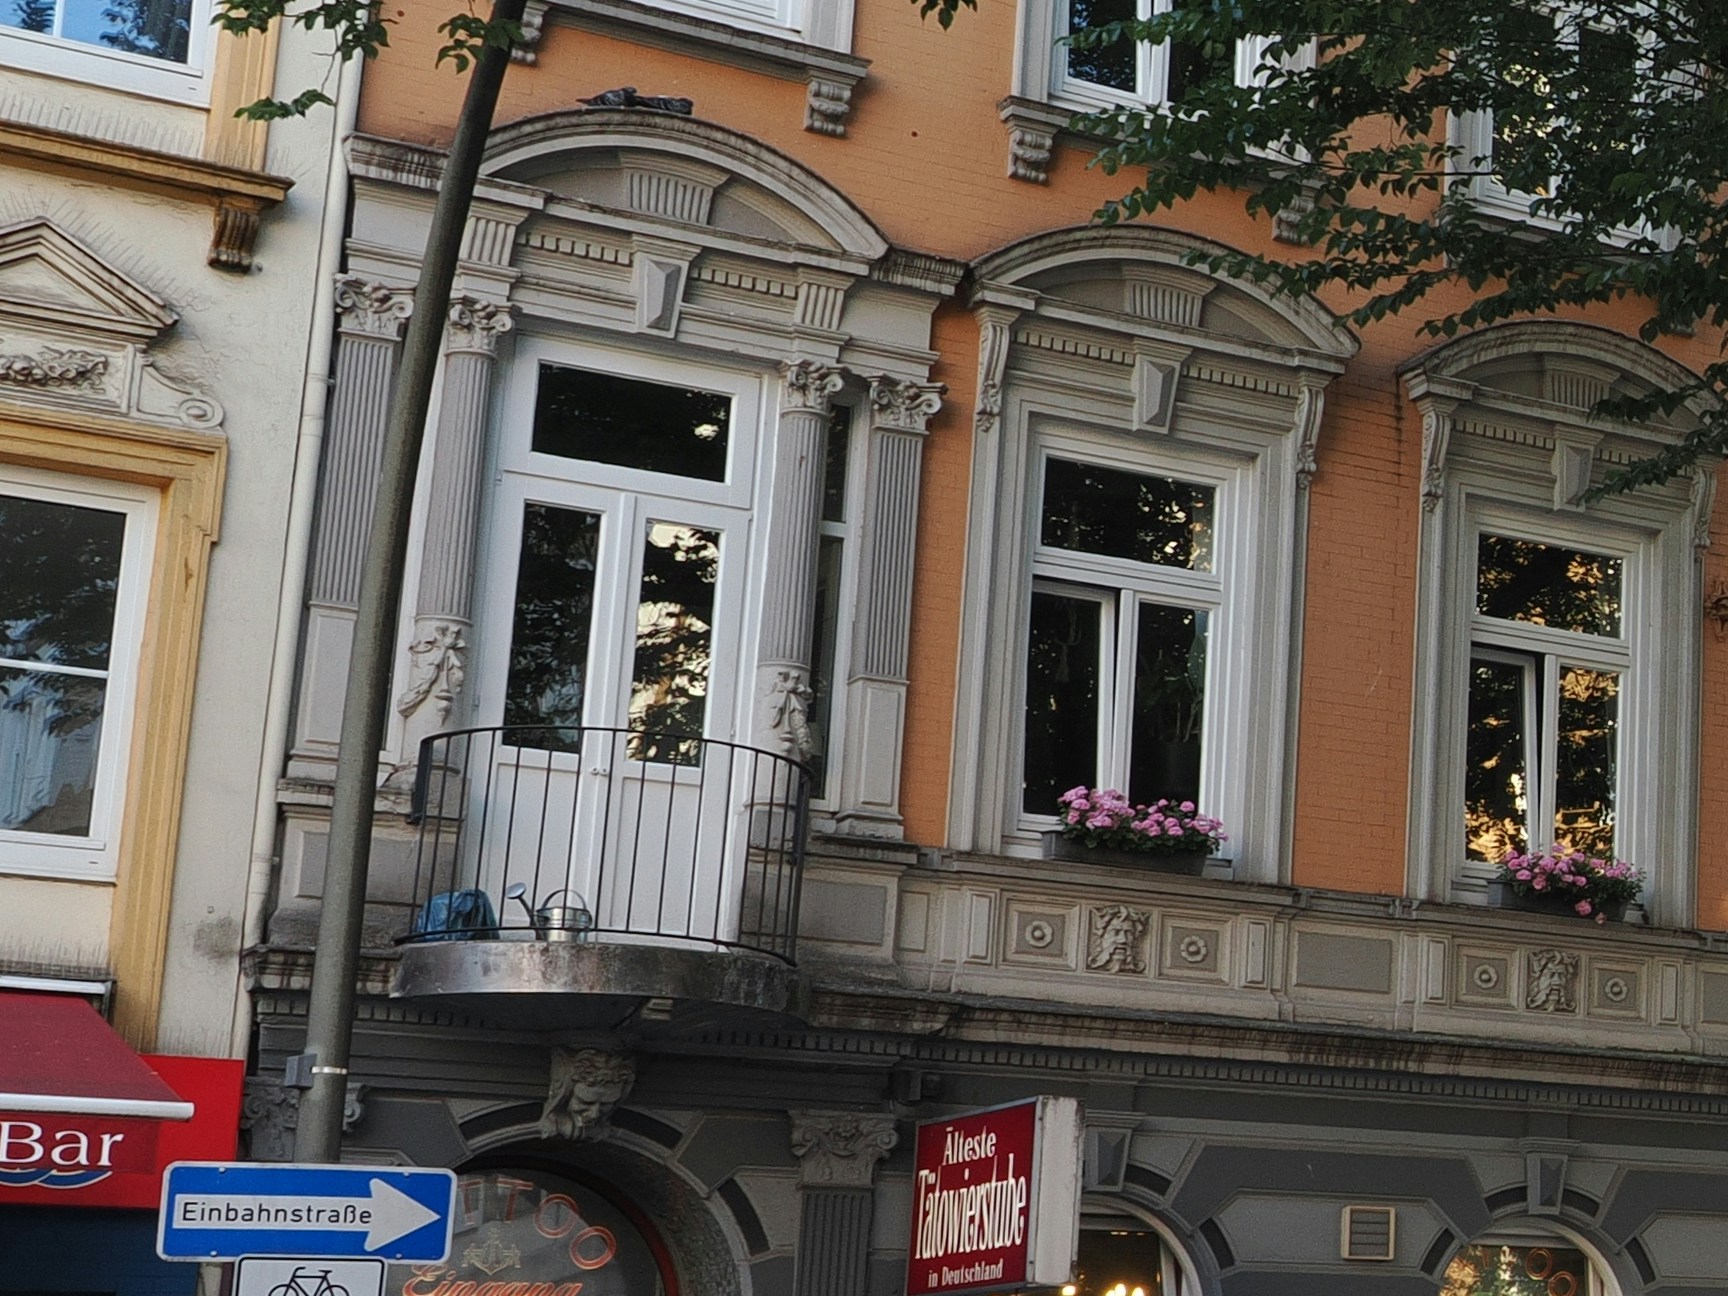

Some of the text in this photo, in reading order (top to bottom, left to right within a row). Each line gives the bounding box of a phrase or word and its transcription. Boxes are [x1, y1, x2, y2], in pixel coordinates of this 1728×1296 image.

[0, 1120, 125, 1167] Bar
[942, 1125, 997, 1166] Älteste
[182, 1202, 373, 1226] Einbahnstraße
[915, 1152, 1026, 1260] Tätowierstube
[928, 1258, 1004, 1288] in Deutschland
